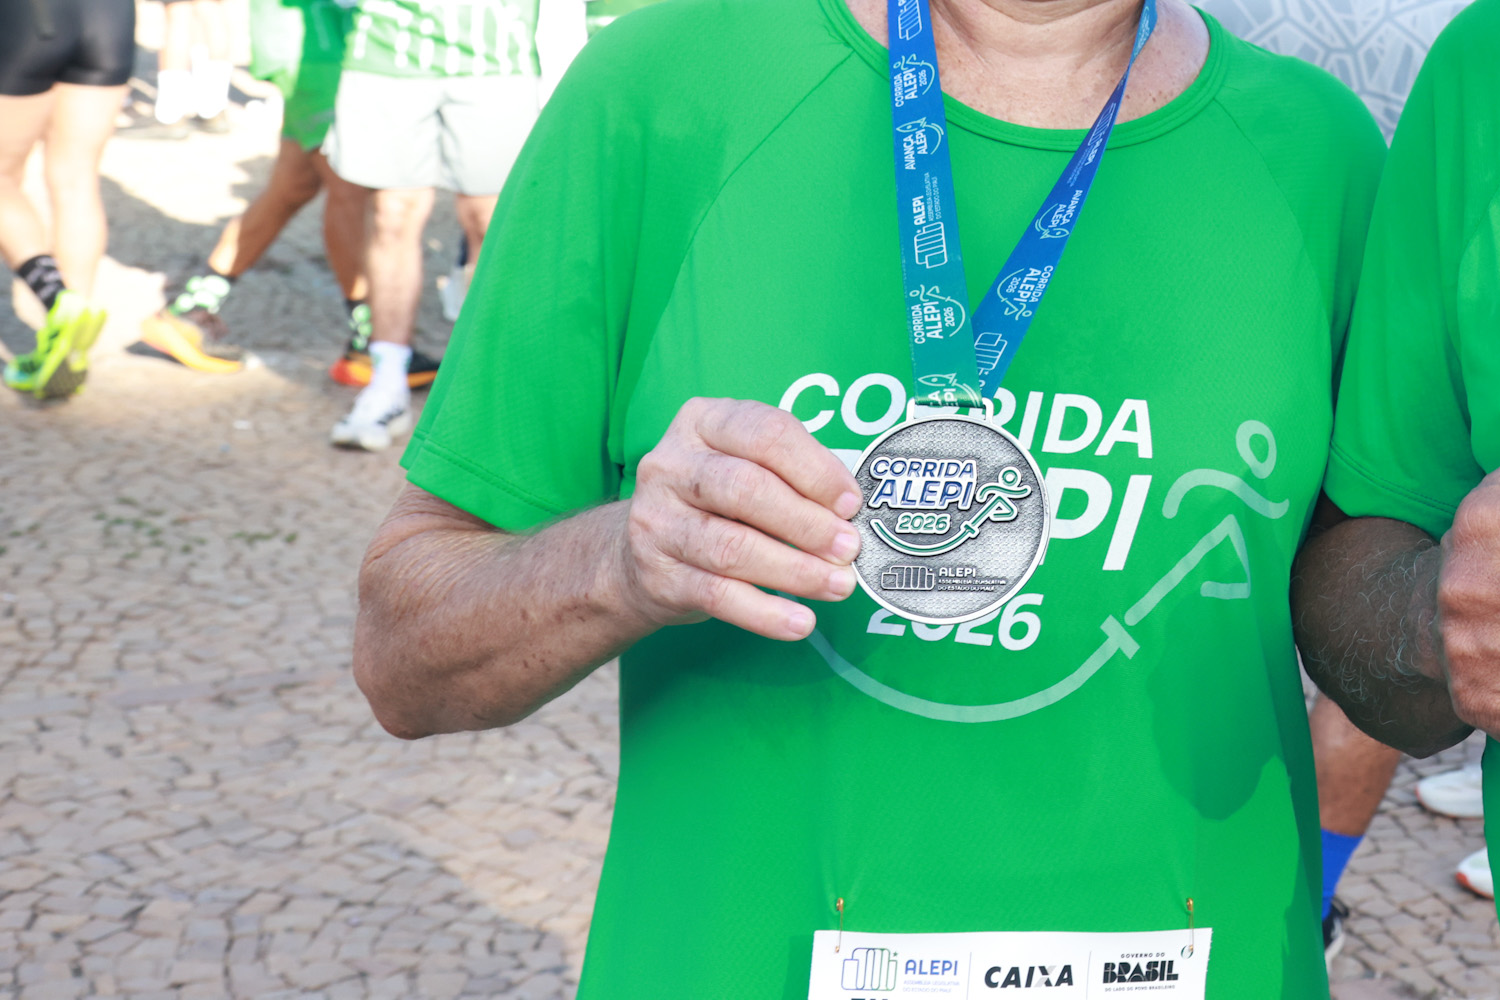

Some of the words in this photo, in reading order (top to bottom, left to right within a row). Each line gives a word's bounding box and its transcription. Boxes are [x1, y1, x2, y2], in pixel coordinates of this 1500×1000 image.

[893, 73, 904, 107] CORRIDA
[903, 68, 918, 100] ALEPI
[915, 128, 928, 155] ALEPI
[912, 195, 926, 226] ALEPI
[1006, 277, 1021, 293] 2026
[1013, 267, 1042, 303] ALEPI
[1028, 265, 1054, 303] CORRIDA
[911, 304, 926, 344] CORRIDA
[923, 301, 944, 339] ALEPI
[943, 306, 956, 327] 2026
[779, 373, 1153, 459] COIDA
[872, 459, 976, 479] CORRIDA
[870, 479, 974, 508] ALEPI
[898, 514, 949, 531] 2026
[938, 567, 976, 578] ALEPI
[905, 959, 958, 976] ALEPI
[984, 964, 1073, 988] CAIXA
[1103, 960, 1179, 984] BRASIL
